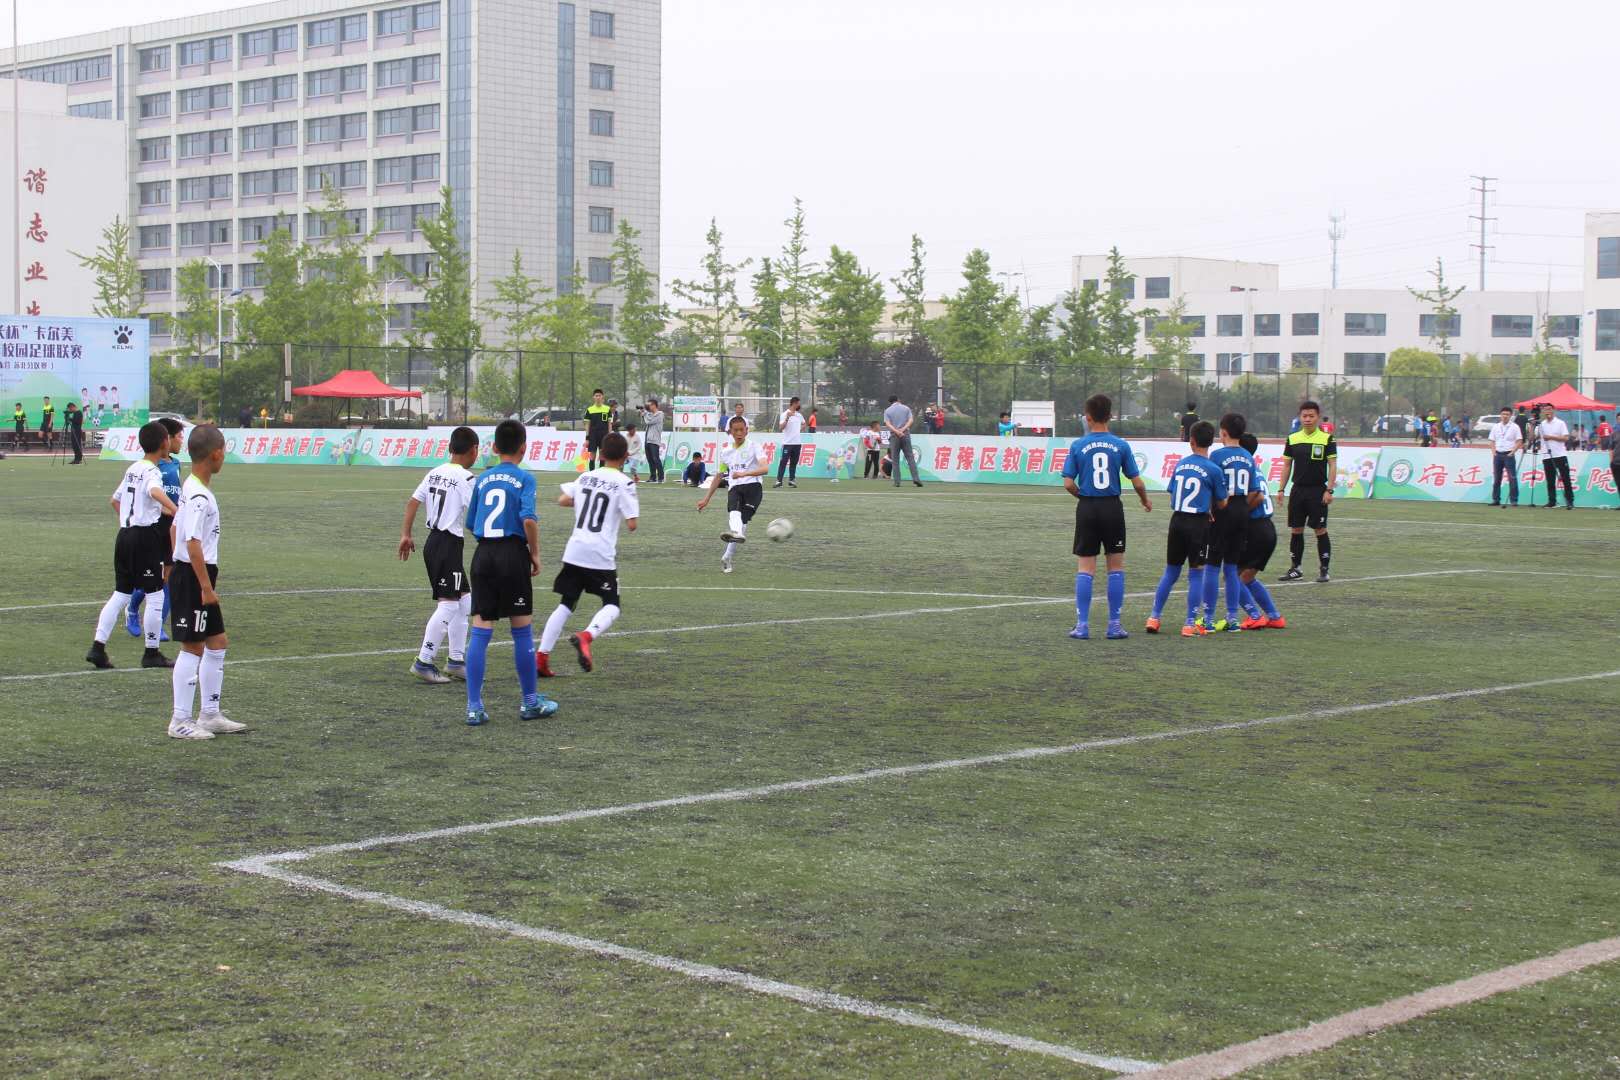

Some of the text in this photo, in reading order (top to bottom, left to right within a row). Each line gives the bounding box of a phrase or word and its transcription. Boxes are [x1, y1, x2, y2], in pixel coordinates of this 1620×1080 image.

[3, 342, 82, 359] 校园足球联赛
[682, 413, 708, 425] 0 1
[242, 436, 326, 457] 江苏省教育厅
[379, 437, 452, 458] 江苏省体育
[934, 445, 1070, 473] 宿豫区教育局
[1092, 452, 1110, 490] 8
[1224, 468, 1250, 497] 19
[1174, 475, 1201, 514] 12
[483, 488, 507, 538] 2
[576, 488, 610, 533] 10
[452, 572, 463, 591] 11
[194, 609, 208, 633] 16
